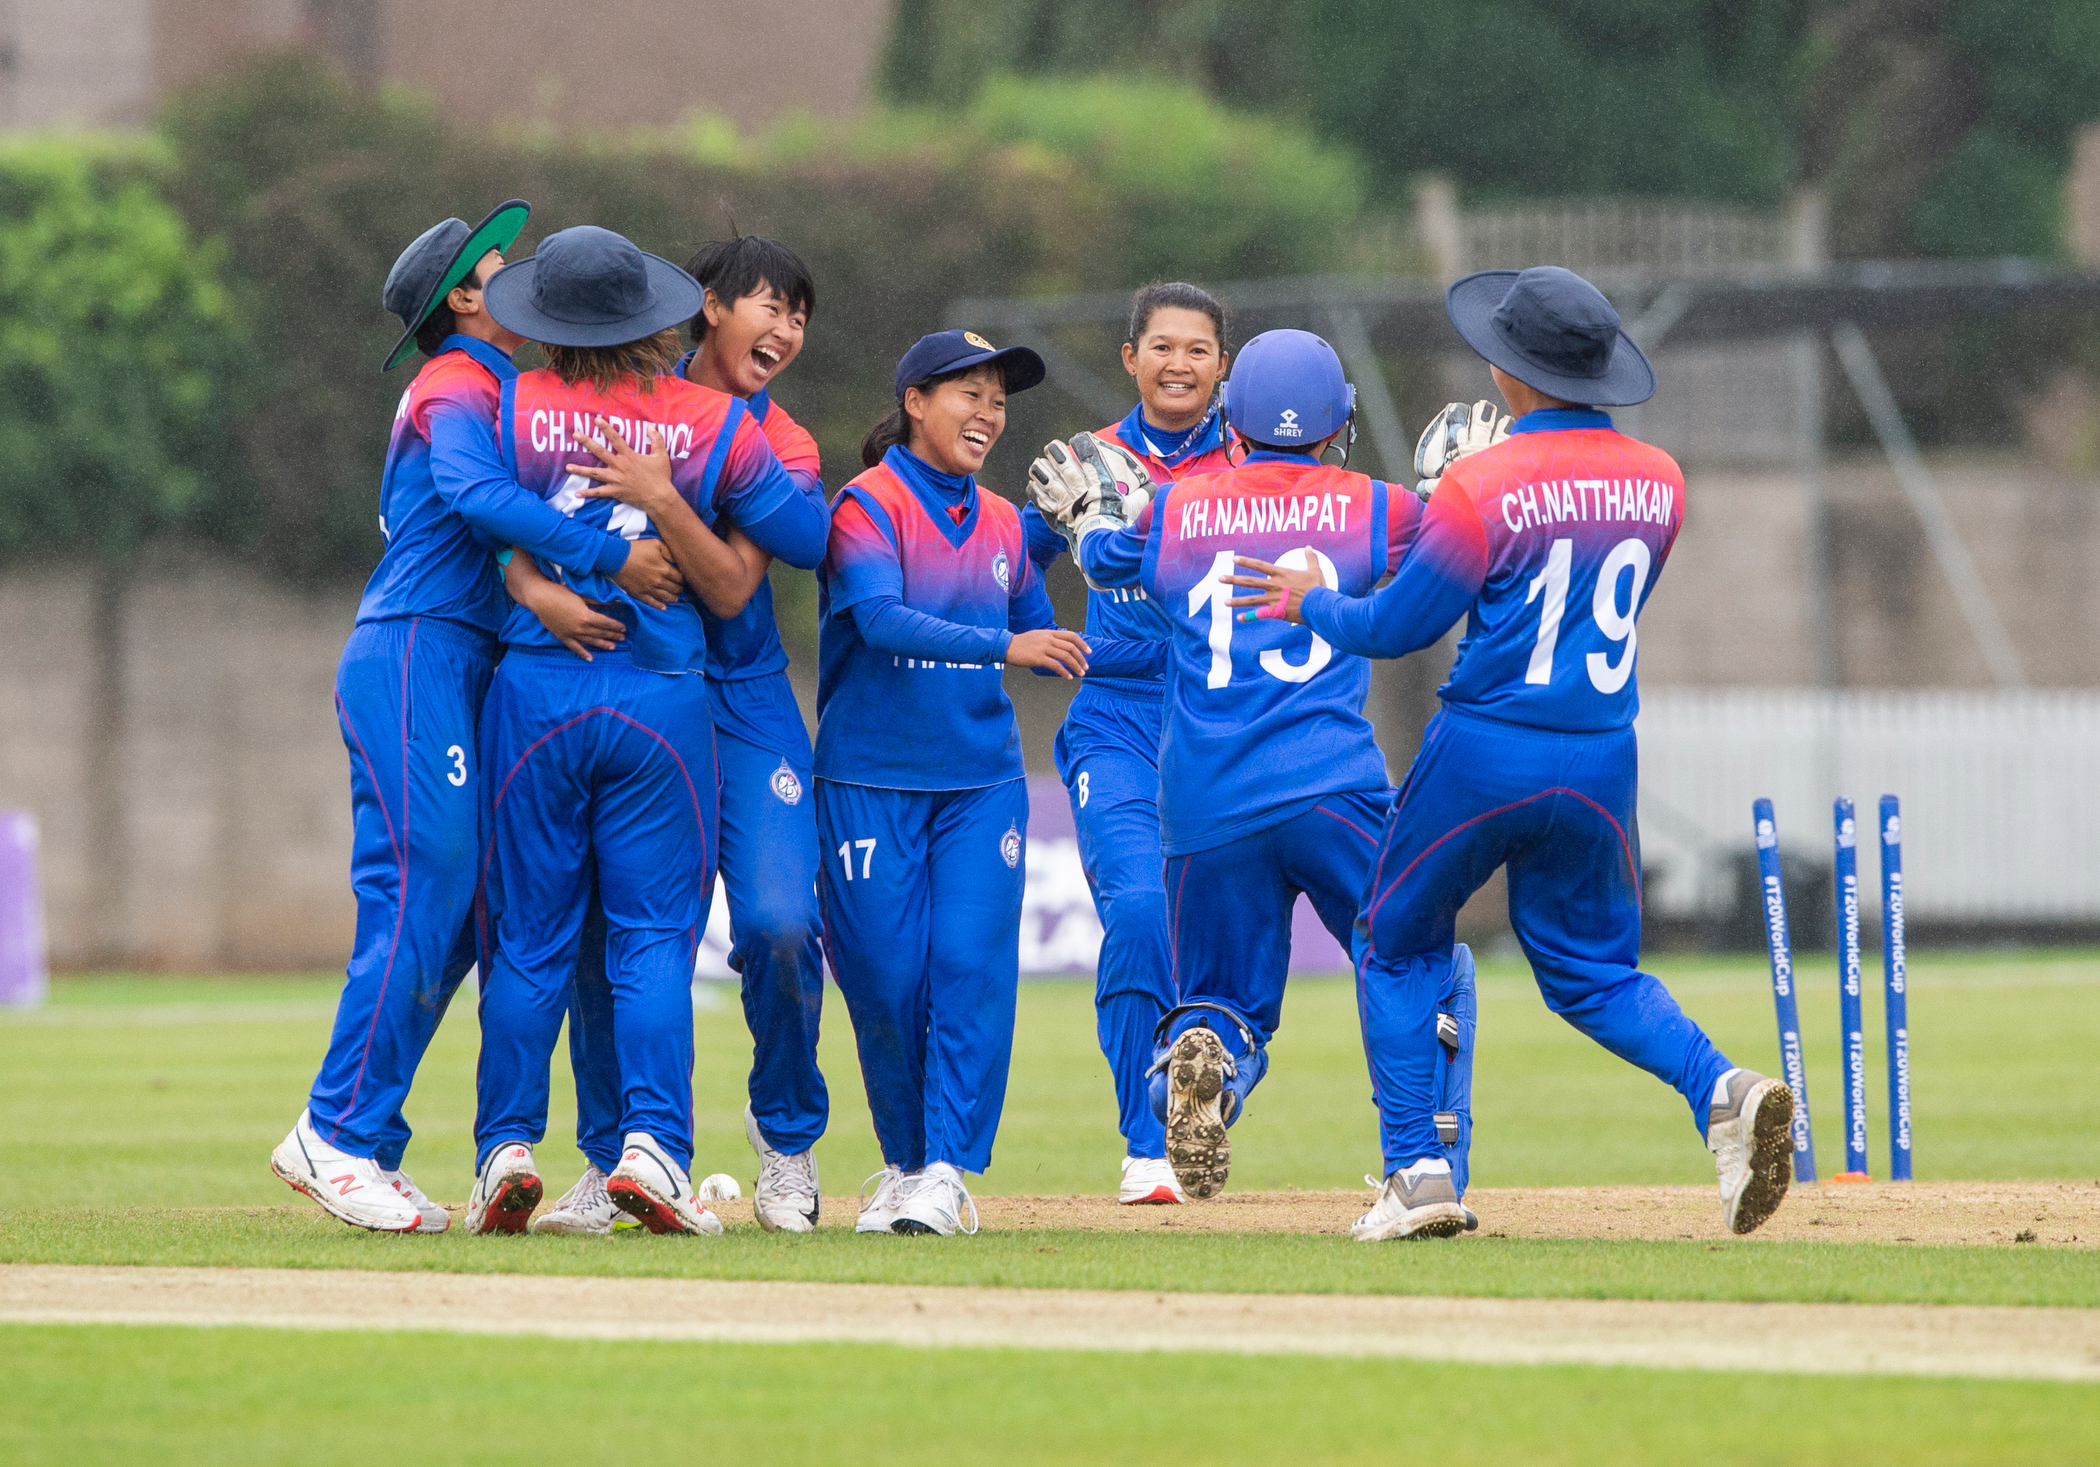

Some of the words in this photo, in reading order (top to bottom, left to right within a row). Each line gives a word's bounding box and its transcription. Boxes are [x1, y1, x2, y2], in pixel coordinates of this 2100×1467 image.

[1273, 427, 1303, 437] SHREY
[1179, 493, 1352, 541] KH.NANNAPAT
[1502, 478, 1674, 534] CH.NATTHAKAN
[1524, 537, 1651, 695] 19
[446, 744, 468, 787] 3
[1077, 771, 1090, 809] 8
[837, 837, 877, 881] 17
[1764, 874, 1792, 997] #T20WorldCup
[1844, 874, 1861, 997] #T20WorldCup
[1890, 871, 1906, 994] #T20WorldCup
[1783, 1031, 1810, 1153] #T20WorldCup
[1850, 1031, 1866, 1154] #T20WorldCup
[1895, 1028, 1911, 1151] #T20WorldCup
